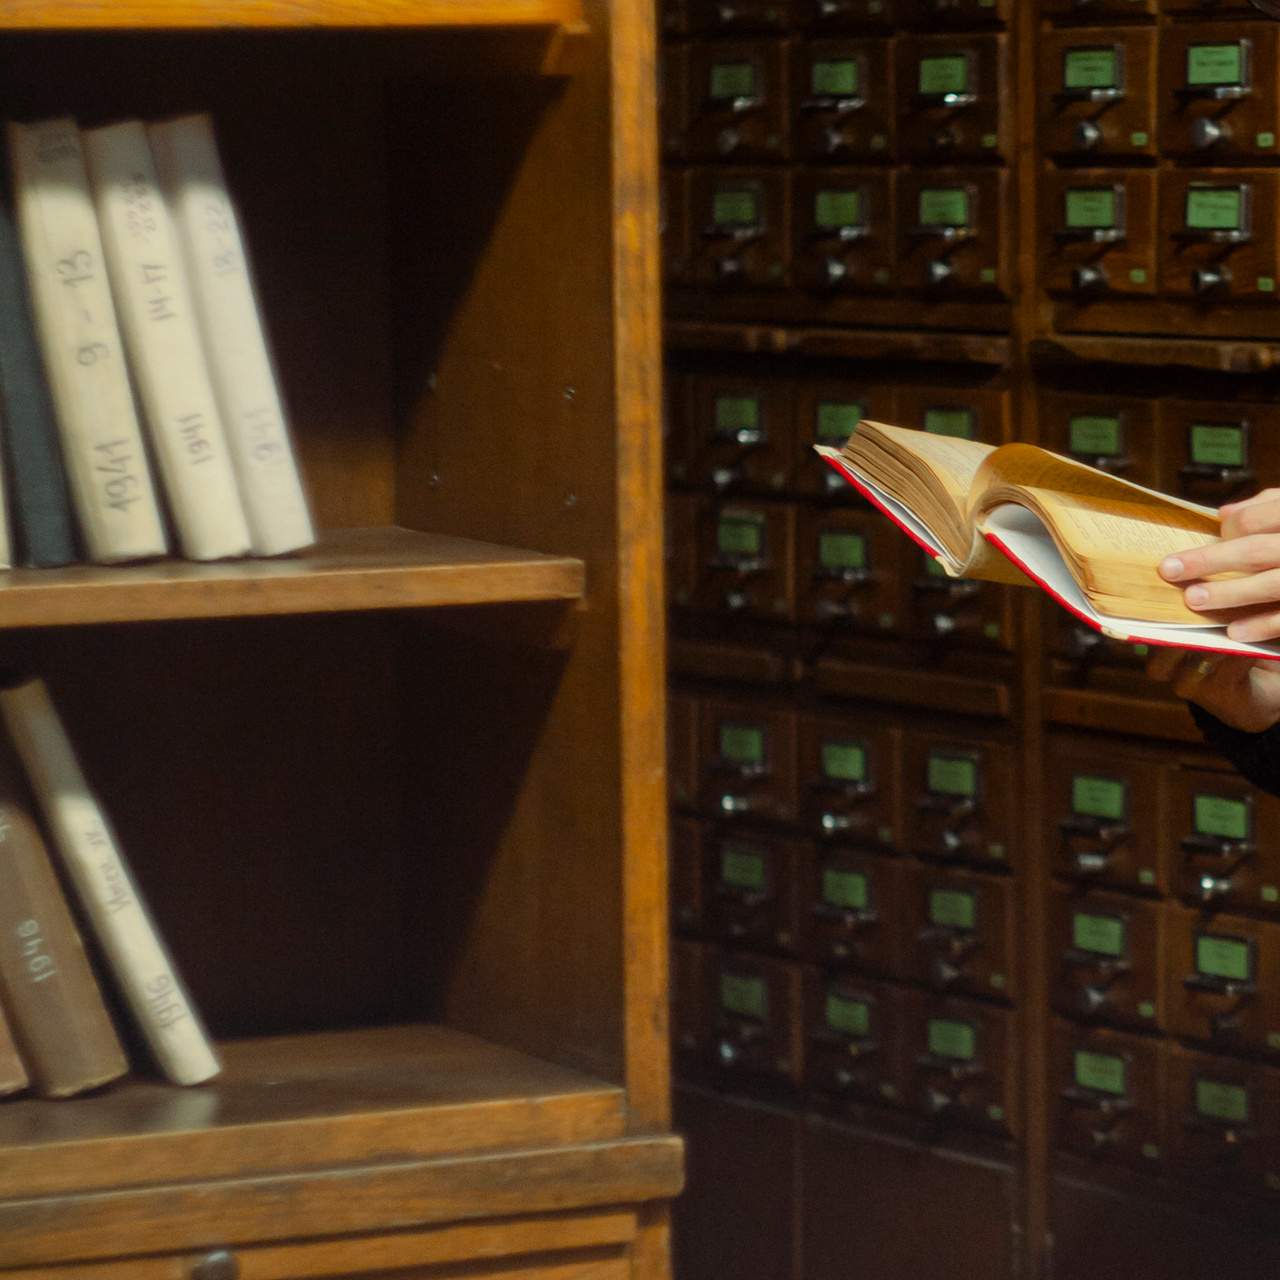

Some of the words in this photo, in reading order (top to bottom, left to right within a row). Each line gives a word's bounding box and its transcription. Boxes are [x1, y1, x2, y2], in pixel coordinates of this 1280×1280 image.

[141, 262, 178, 322] 14-17
[178, 411, 215, 467] 1941
[94, 436, 143, 513] 1941
[16, 918, 58, 983] 1946
